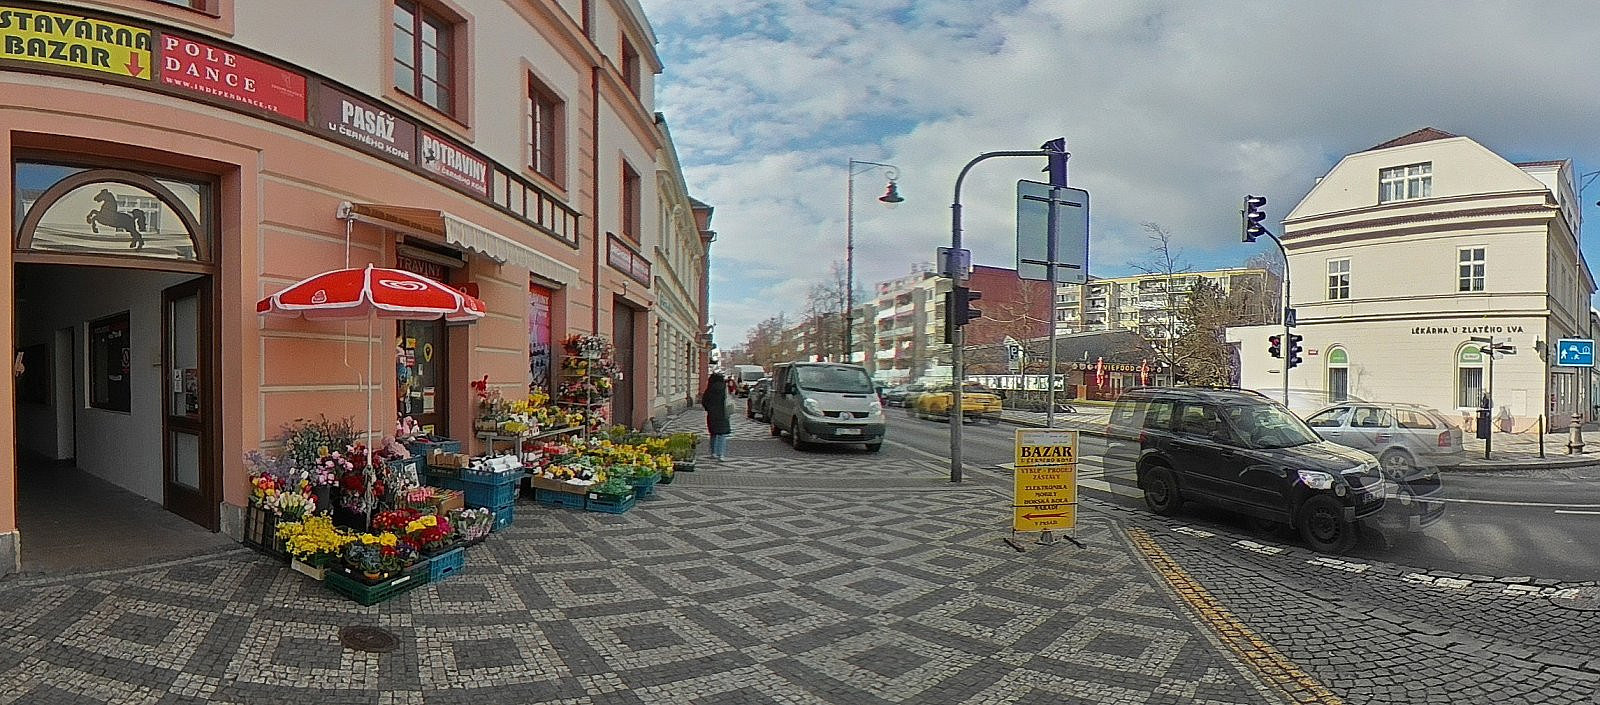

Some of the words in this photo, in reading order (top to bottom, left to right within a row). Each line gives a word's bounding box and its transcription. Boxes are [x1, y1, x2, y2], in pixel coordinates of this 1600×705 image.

[5, 35, 111, 68] BAZAR
[166, 37, 236, 68] POLE
[165, 56, 256, 93] DANCE
[328, 122, 337, 131] U
[339, 123, 385, 150] ČERNÉHO
[342, 100, 395, 143] PASÁŽ
[423, 134, 487, 183] POTRAVINY
[1411, 326, 1449, 334] LÉKÁRNA
[1462, 325, 1503, 334] ZLATÉHO
[1507, 326, 1524, 334] LVA
[1021, 446, 1073, 458] BAZAR
